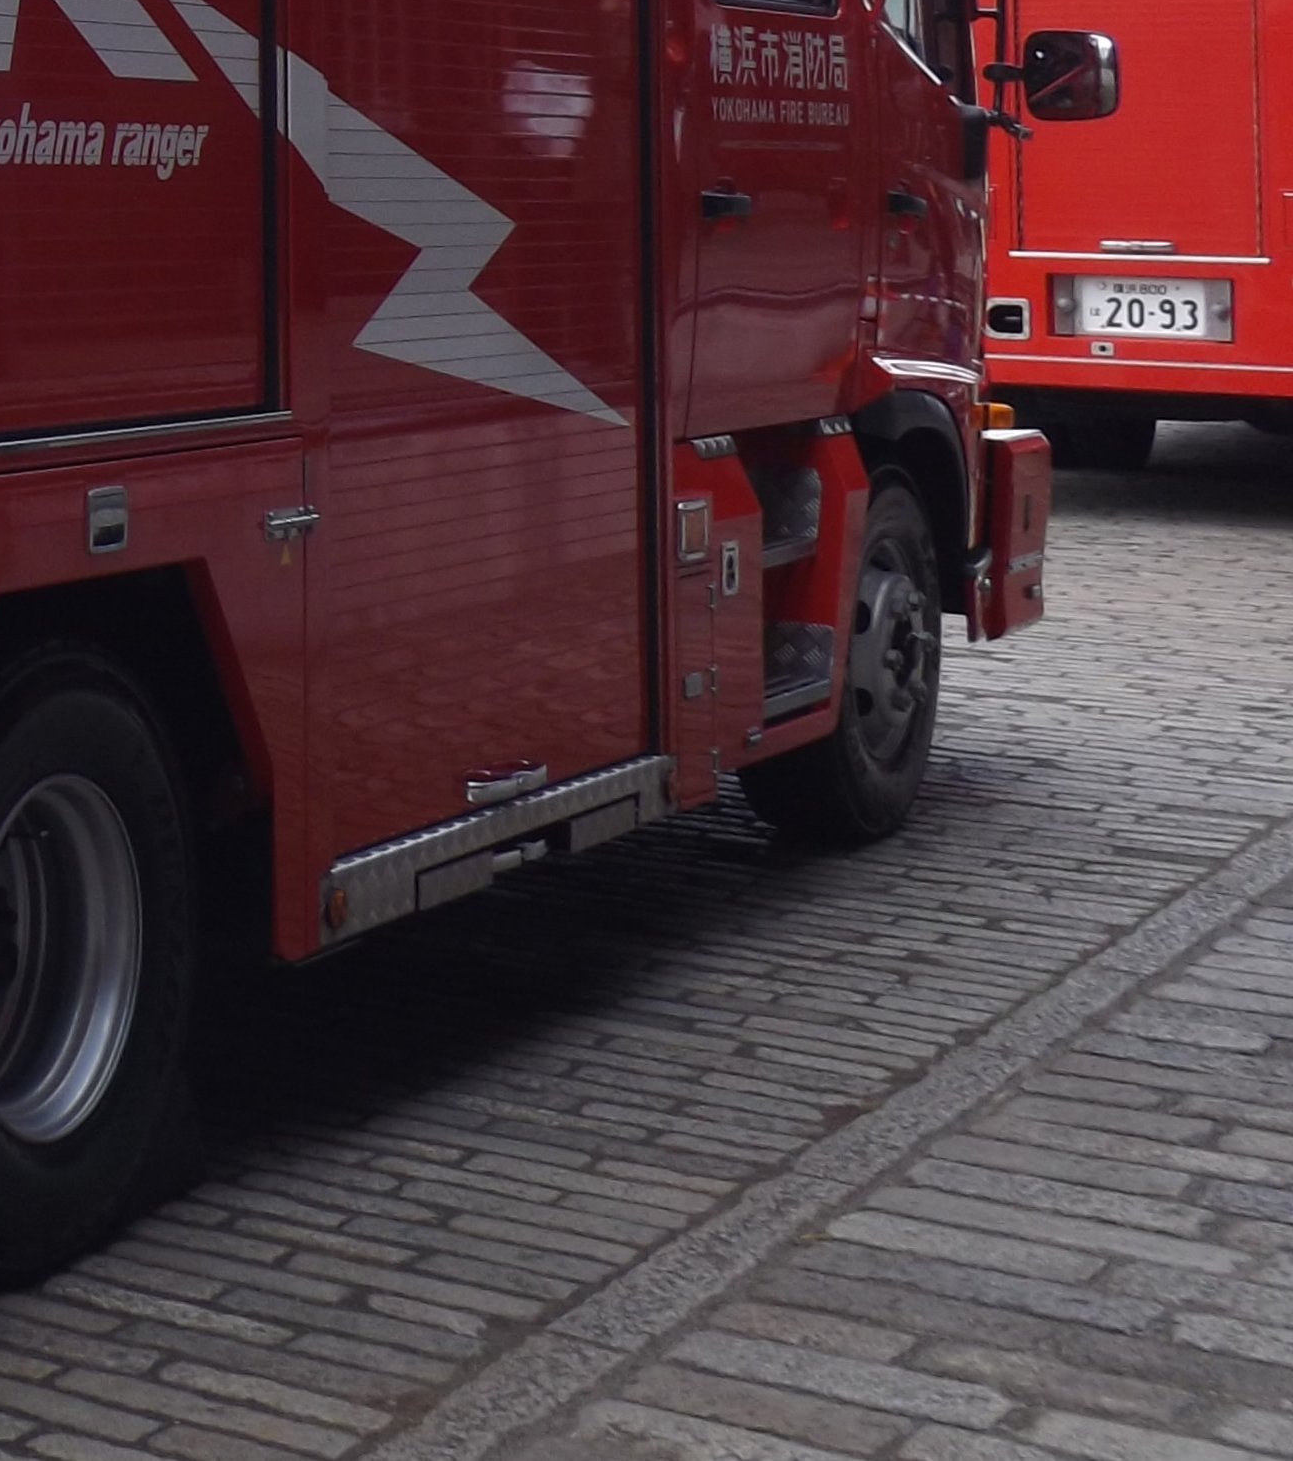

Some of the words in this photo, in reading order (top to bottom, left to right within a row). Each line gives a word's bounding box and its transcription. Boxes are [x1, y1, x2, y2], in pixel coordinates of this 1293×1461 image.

[710, 23, 848, 90] 横浜市消防局
[712, 96, 775, 123] YOKOHAMA
[780, 100, 804, 124] FIRE
[808, 101, 850, 126] BUREAU
[110, 121, 209, 180] ranger
[1105, 297, 1199, 331] 20-93
